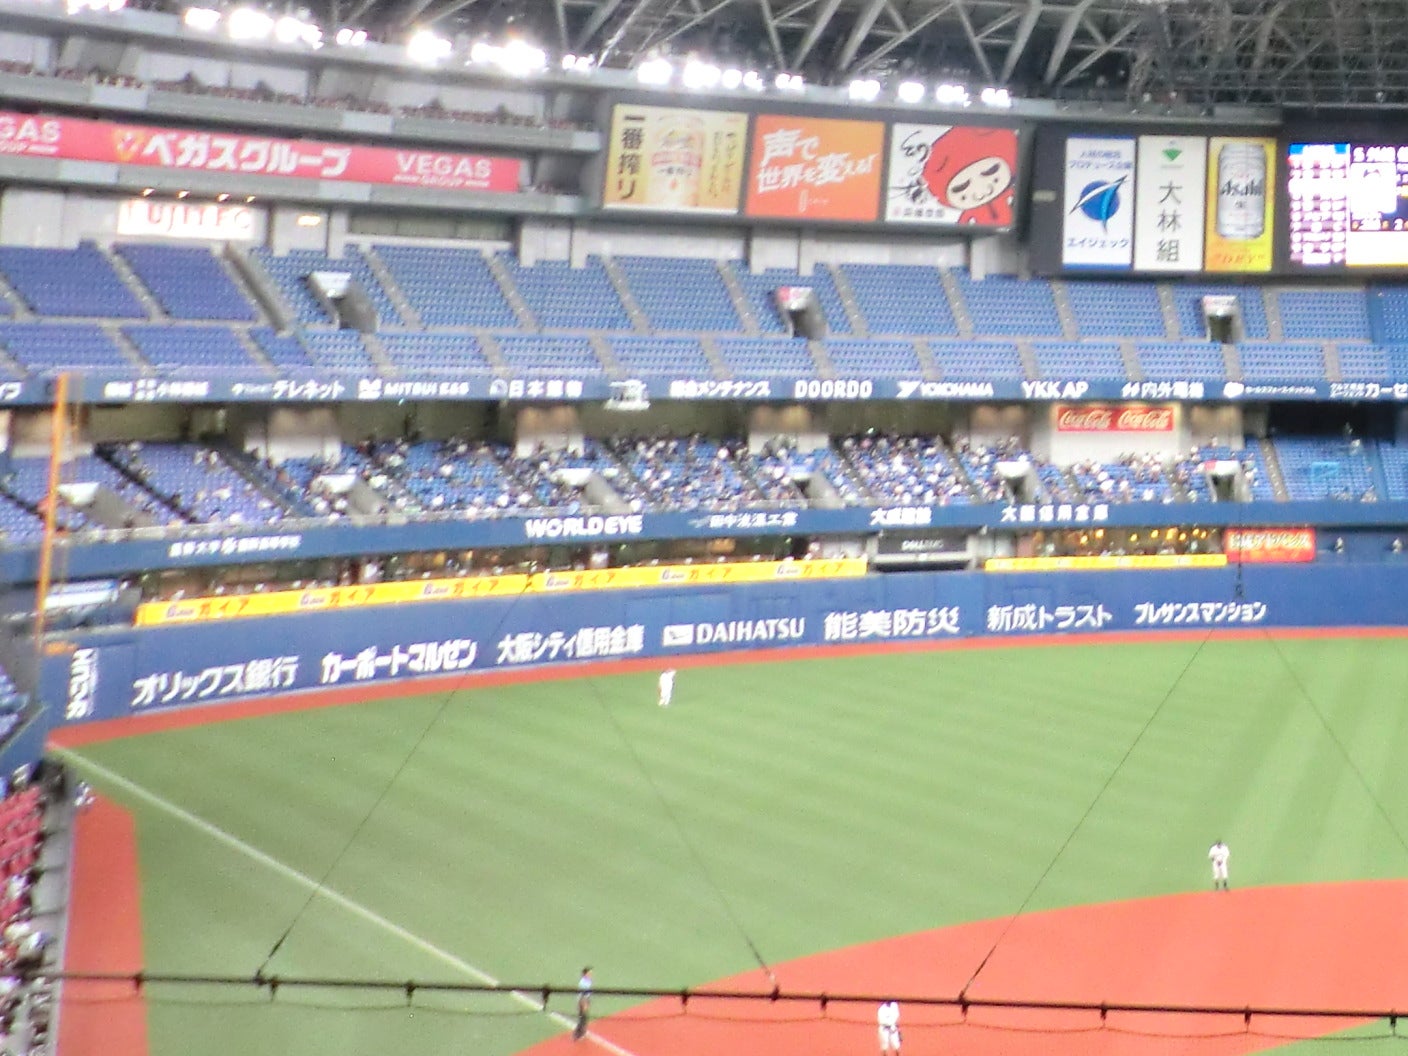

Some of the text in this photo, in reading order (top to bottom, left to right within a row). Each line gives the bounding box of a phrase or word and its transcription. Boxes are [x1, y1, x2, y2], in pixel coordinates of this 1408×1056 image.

[141, 131, 351, 177] ベガスグループ
[617, 115, 646, 200] 一番搾り
[762, 128, 820, 166] 声で
[396, 153, 492, 179] VEGAS
[1220, 178, 1263, 196] Asahi
[1157, 180, 1184, 263] 大林組
[273, 379, 345, 400] テレネット
[919, 382, 994, 396] YOKOHAMA
[1021, 381, 1089, 398] YKK AP
[525, 514, 643, 538] WORLD EYE
[824, 606, 960, 641] 能美防災
[987, 603, 1113, 632] 新成トラスト
[1134, 600, 1267, 626] プレサンスマンション
[496, 624, 646, 665] 大阪シティ信用金庫
[697, 617, 805, 644] DAIHATSU
[321, 638, 478, 684] カーポートマルゼン
[131, 654, 300, 707] オリックス銀行
